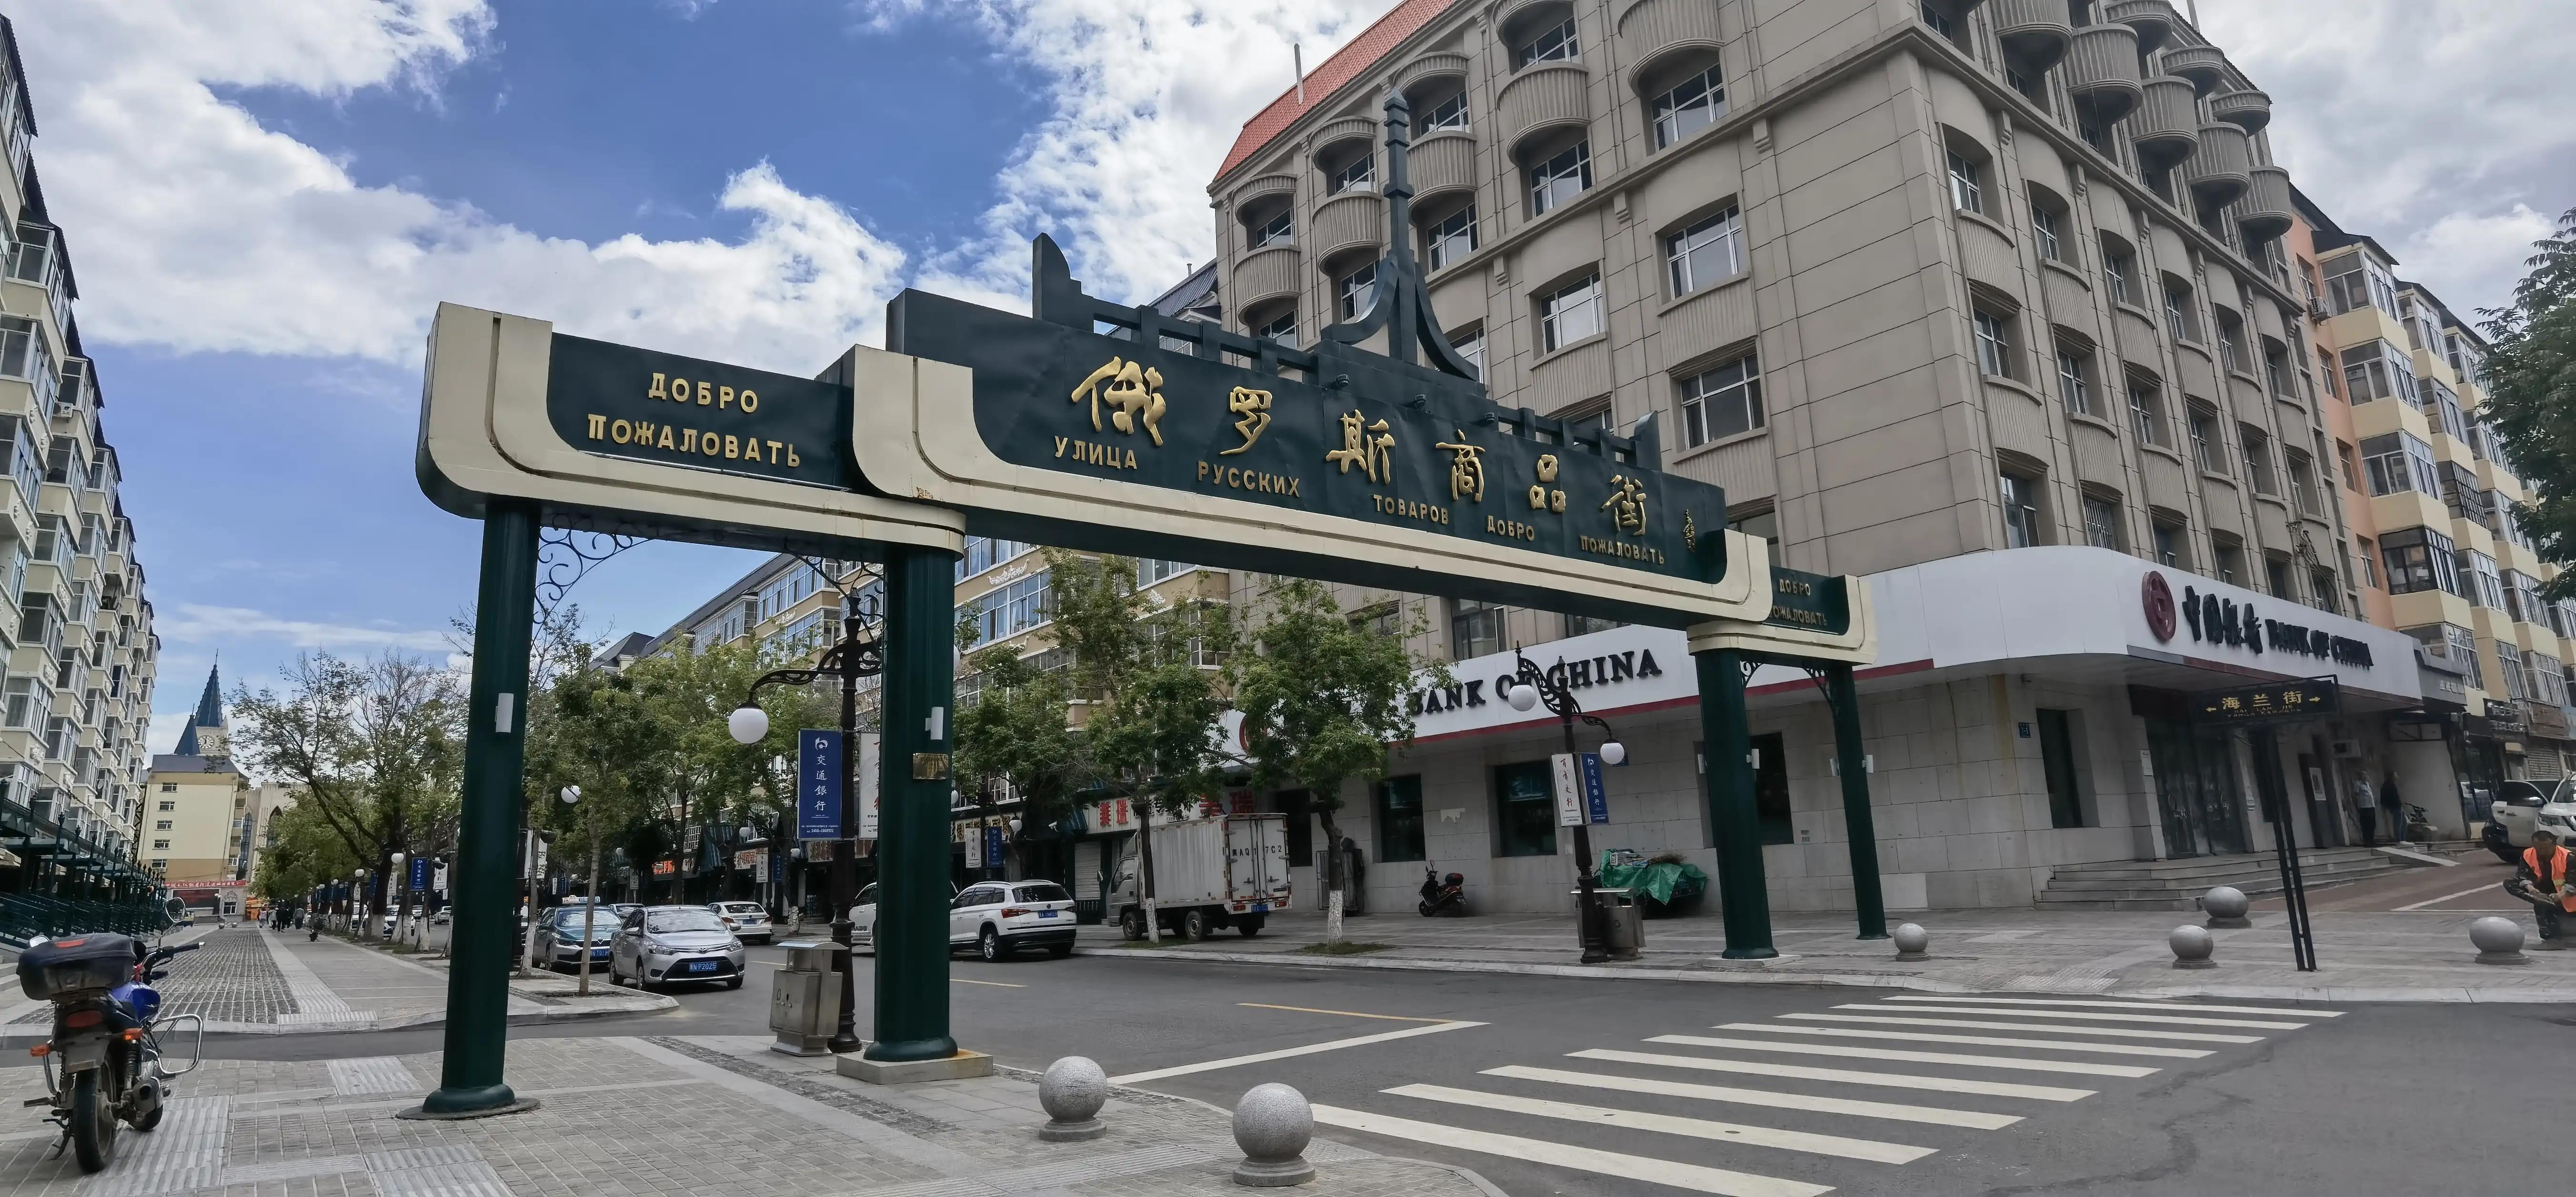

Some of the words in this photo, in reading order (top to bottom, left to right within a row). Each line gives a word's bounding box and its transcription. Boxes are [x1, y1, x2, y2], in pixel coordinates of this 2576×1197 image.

[648, 373, 758, 413] ДОБРО
[588, 414, 800, 467] ПОЖАЛОВАТЬ
[1071, 356, 1646, 536] 俄罗斯商品街
[1055, 436, 1137, 470] УЛИЦА
[1198, 460, 1300, 497] РУССКИХ
[1374, 494, 1448, 525] ТОВАРОВ
[1487, 515, 1535, 541] ДОБРО
[1580, 535, 1665, 565] ПОЖАЛОВАТЬ
[1779, 579, 1811, 596] ДОБРО
[1769, 605, 1827, 626] ОЖАЛОВАТЬ
[2222, 691, 2302, 710] 海兰街
